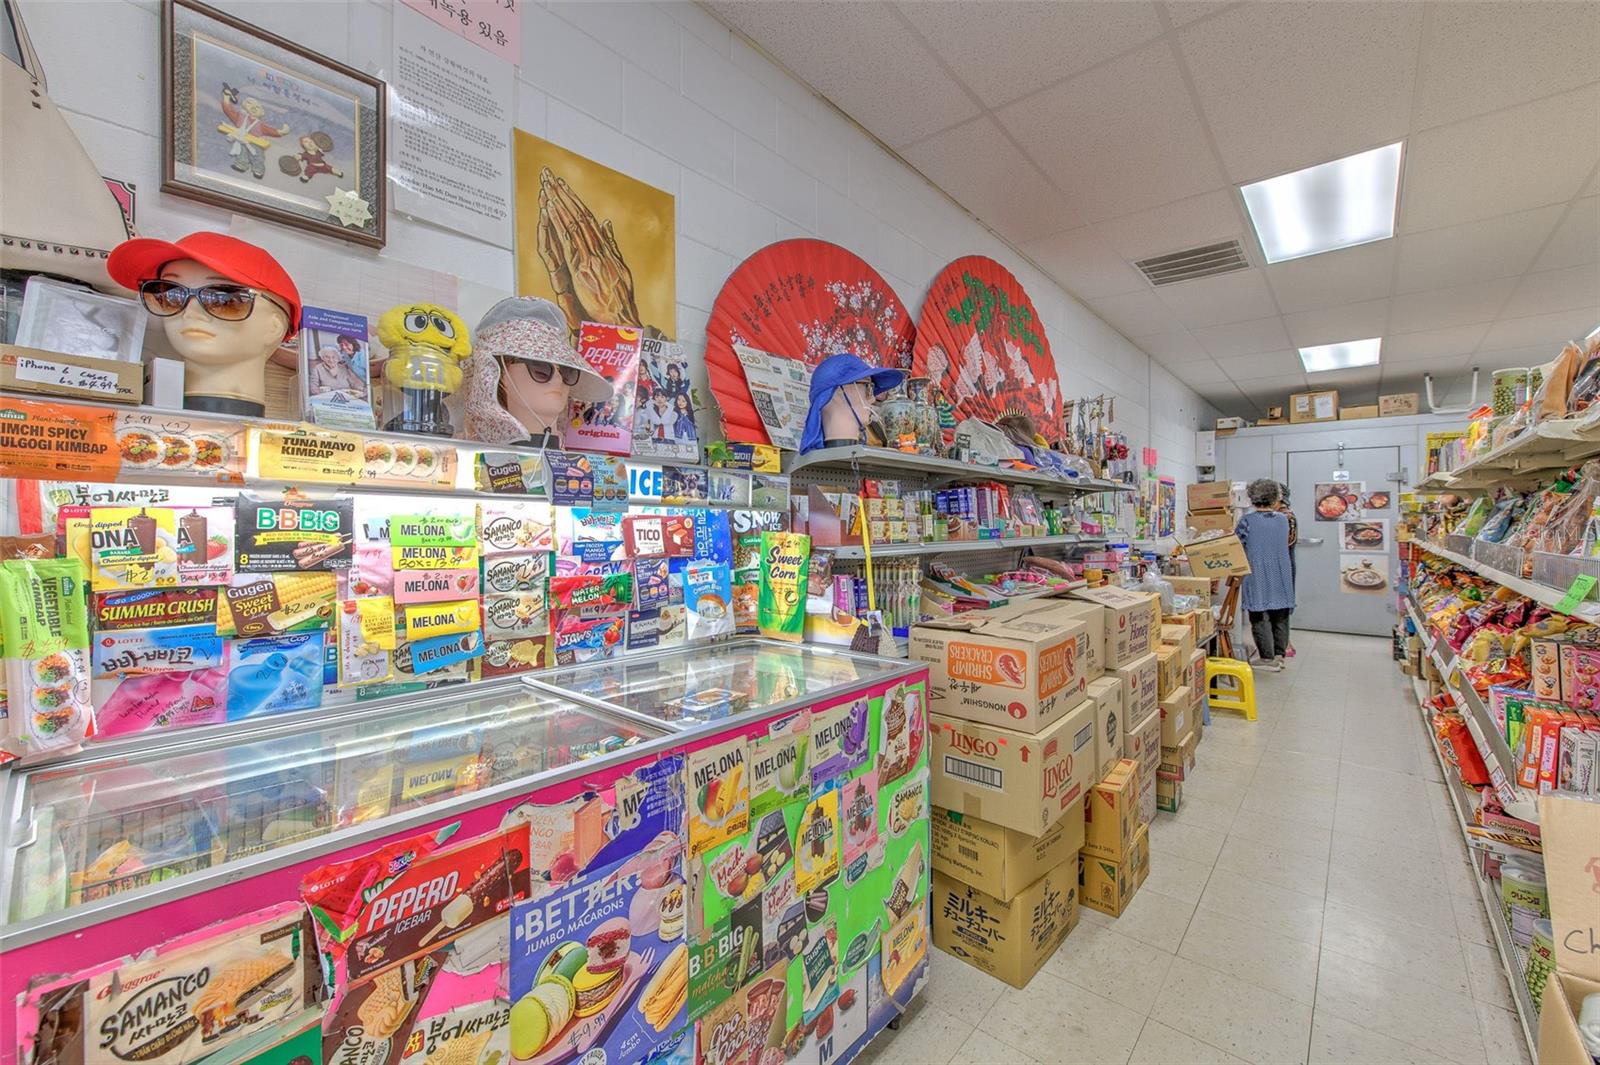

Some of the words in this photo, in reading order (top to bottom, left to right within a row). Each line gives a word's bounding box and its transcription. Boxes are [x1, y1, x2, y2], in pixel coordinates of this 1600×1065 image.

[479, 21, 509, 46] 있음
[584, 346, 635, 367] PEPERO
[641, 340, 662, 354] ERO
[1, 422, 44, 437] IMCHI
[47, 427, 88, 440] SPICY
[578, 429, 620, 440] original
[0, 436, 52, 451] ULGOGI
[56, 440, 108, 455] KIMBAP
[281, 446, 334, 459] KIMBAP
[282, 437, 318, 448] TUNA
[320, 440, 356, 452] MAYO
[630, 469, 662, 497] ICE
[95, 519, 123, 529] dipped
[400, 524, 446, 537] MELONA
[483, 519, 522, 541] SAMANCO
[732, 509, 781, 533] SNOW
[769, 523, 782, 531] ICE
[91, 528, 138, 549] ONA
[635, 528, 660, 541] TICO
[102, 556, 135, 564] Chocolate
[136, 554, 160, 563] dipped
[239, 553, 249, 565] 8
[398, 558, 424, 568] BOX
[402, 547, 447, 559] MELONA
[766, 545, 803, 566] Sweet
[487, 562, 521, 583] SAMANCO
[770, 566, 796, 580] Corn
[404, 579, 450, 593] MELONA
[572, 585, 601, 597] WATER
[31, 577, 47, 627] KIMBAP
[42, 576, 62, 637] VEGETABLE
[100, 602, 166, 621] SUMMER
[167, 598, 215, 615] CRUSH
[235, 594, 274, 612] Sweet
[487, 598, 521, 619] SAMANCO
[571, 593, 600, 605] MELON
[242, 605, 272, 617] corn
[412, 615, 455, 629] MELONA
[1130, 622, 1148, 641] Honey
[559, 630, 592, 646] JAWS
[418, 641, 461, 663] MELONA
[949, 644, 993, 662] CRACKERS
[952, 662, 993, 680] SHRIMP
[960, 696, 1007, 712] NONGSHIM
[814, 715, 852, 751] MELONA
[949, 728, 999, 757] LINGO
[693, 747, 744, 789] MELONA
[754, 745, 797, 781] MELONA
[1042, 753, 1074, 799] LINGO
[894, 783, 924, 808] SAMANCO
[846, 794, 874, 821] MELONA
[531, 828, 554, 838] NGO
[801, 816, 833, 848] MELONA
[1488, 820, 1530, 835] Chocolate
[320, 875, 346, 889] LOTTE
[366, 870, 460, 932] PEPERO
[946, 891, 1001, 924] ミルキー
[567, 897, 625, 935] MACARONS
[943, 906, 1006, 942] チューチューバー
[524, 929, 565, 957] JUMBO
[96, 968, 165, 1000] Bggrae
[99, 966, 210, 1049] SAMANCO
[129, 1002, 188, 1045] 싸만코
[426, 1007, 511, 1056] 붕어싸만코
[341, 1025, 365, 1065] ANCO
[620, 1031, 638, 1049] 4cm
